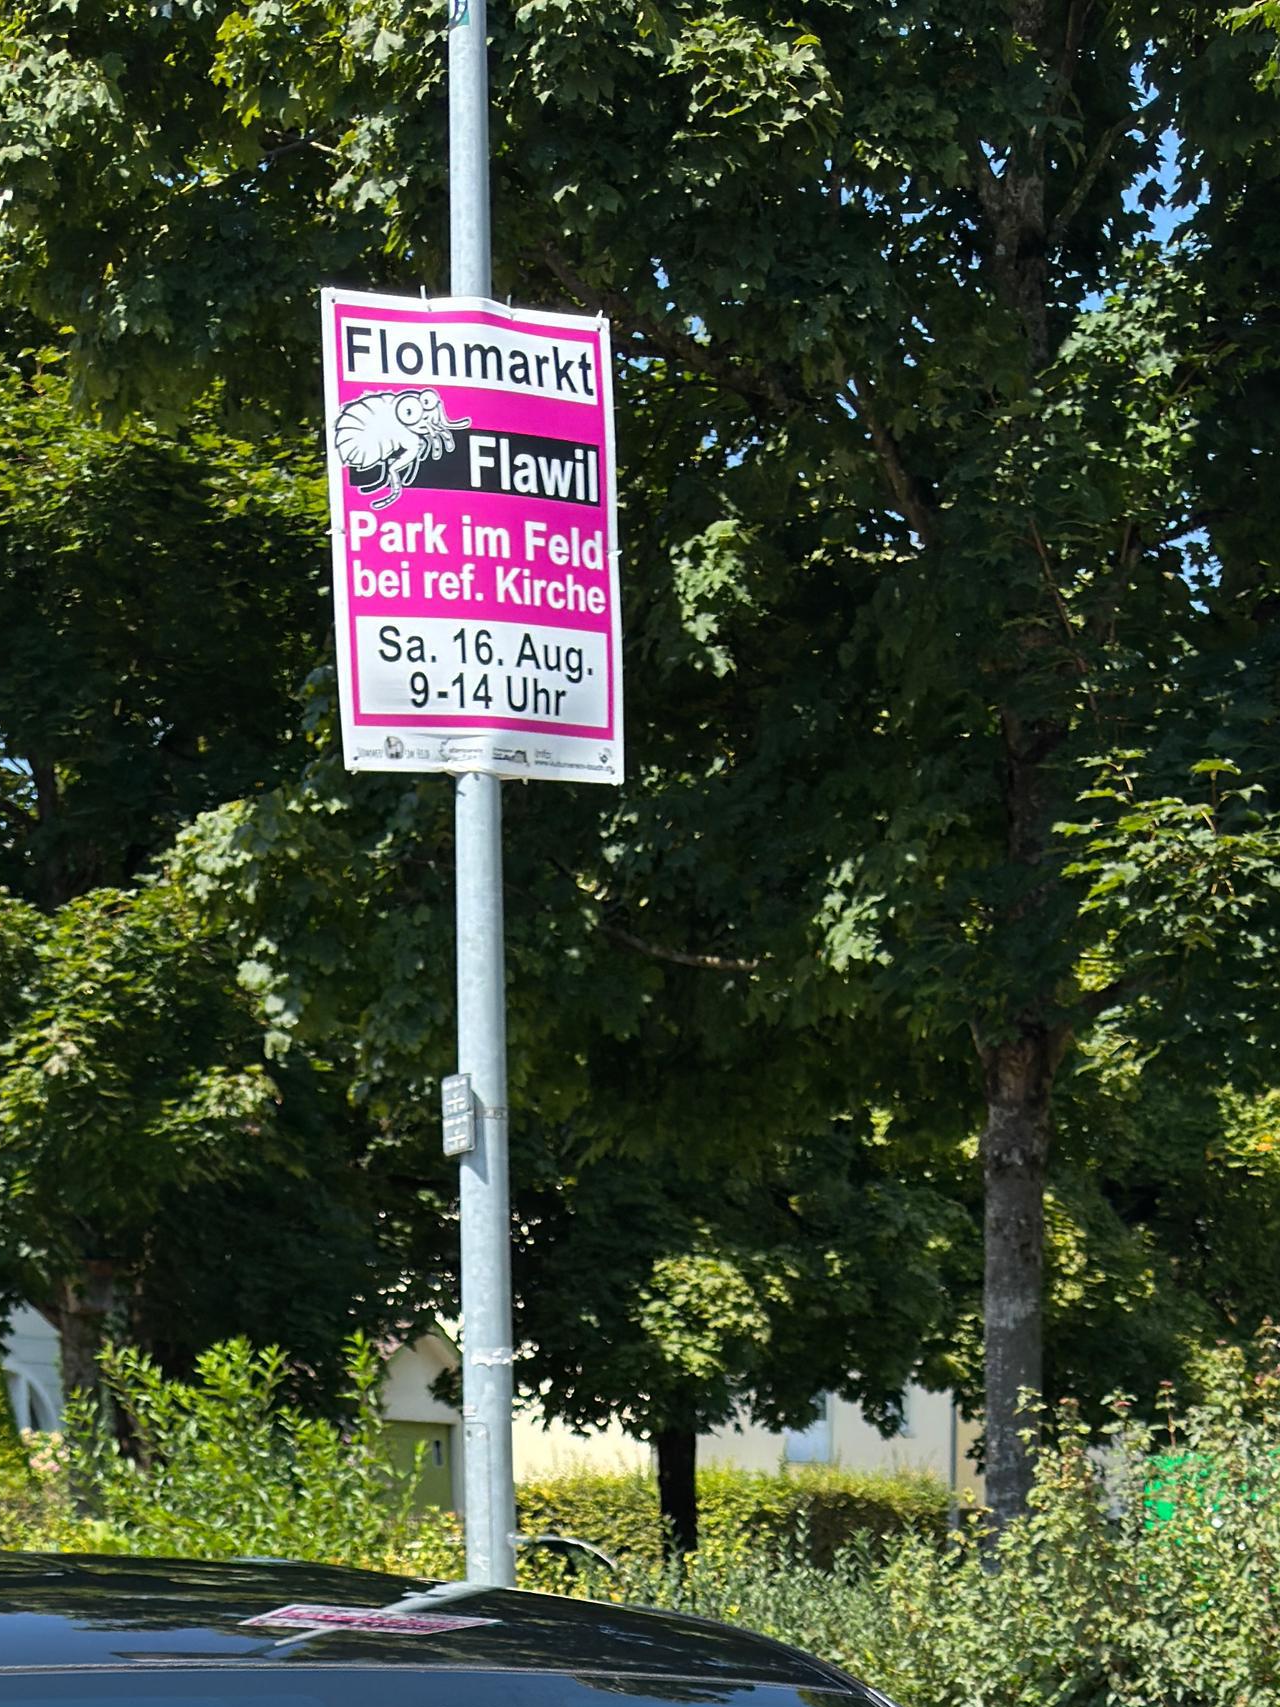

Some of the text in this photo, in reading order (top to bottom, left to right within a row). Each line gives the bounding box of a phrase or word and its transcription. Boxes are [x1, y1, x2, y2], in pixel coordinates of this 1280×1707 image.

[345, 325, 594, 397] Flohmarkt
[468, 434, 598, 503] Flawil
[348, 510, 604, 571] Park im Feld
[352, 559, 606, 615] bei ref. Kirche
[377, 625, 594, 684] Sa. 16. Aug.
[409, 671, 567, 717] 9-14 Uhr
